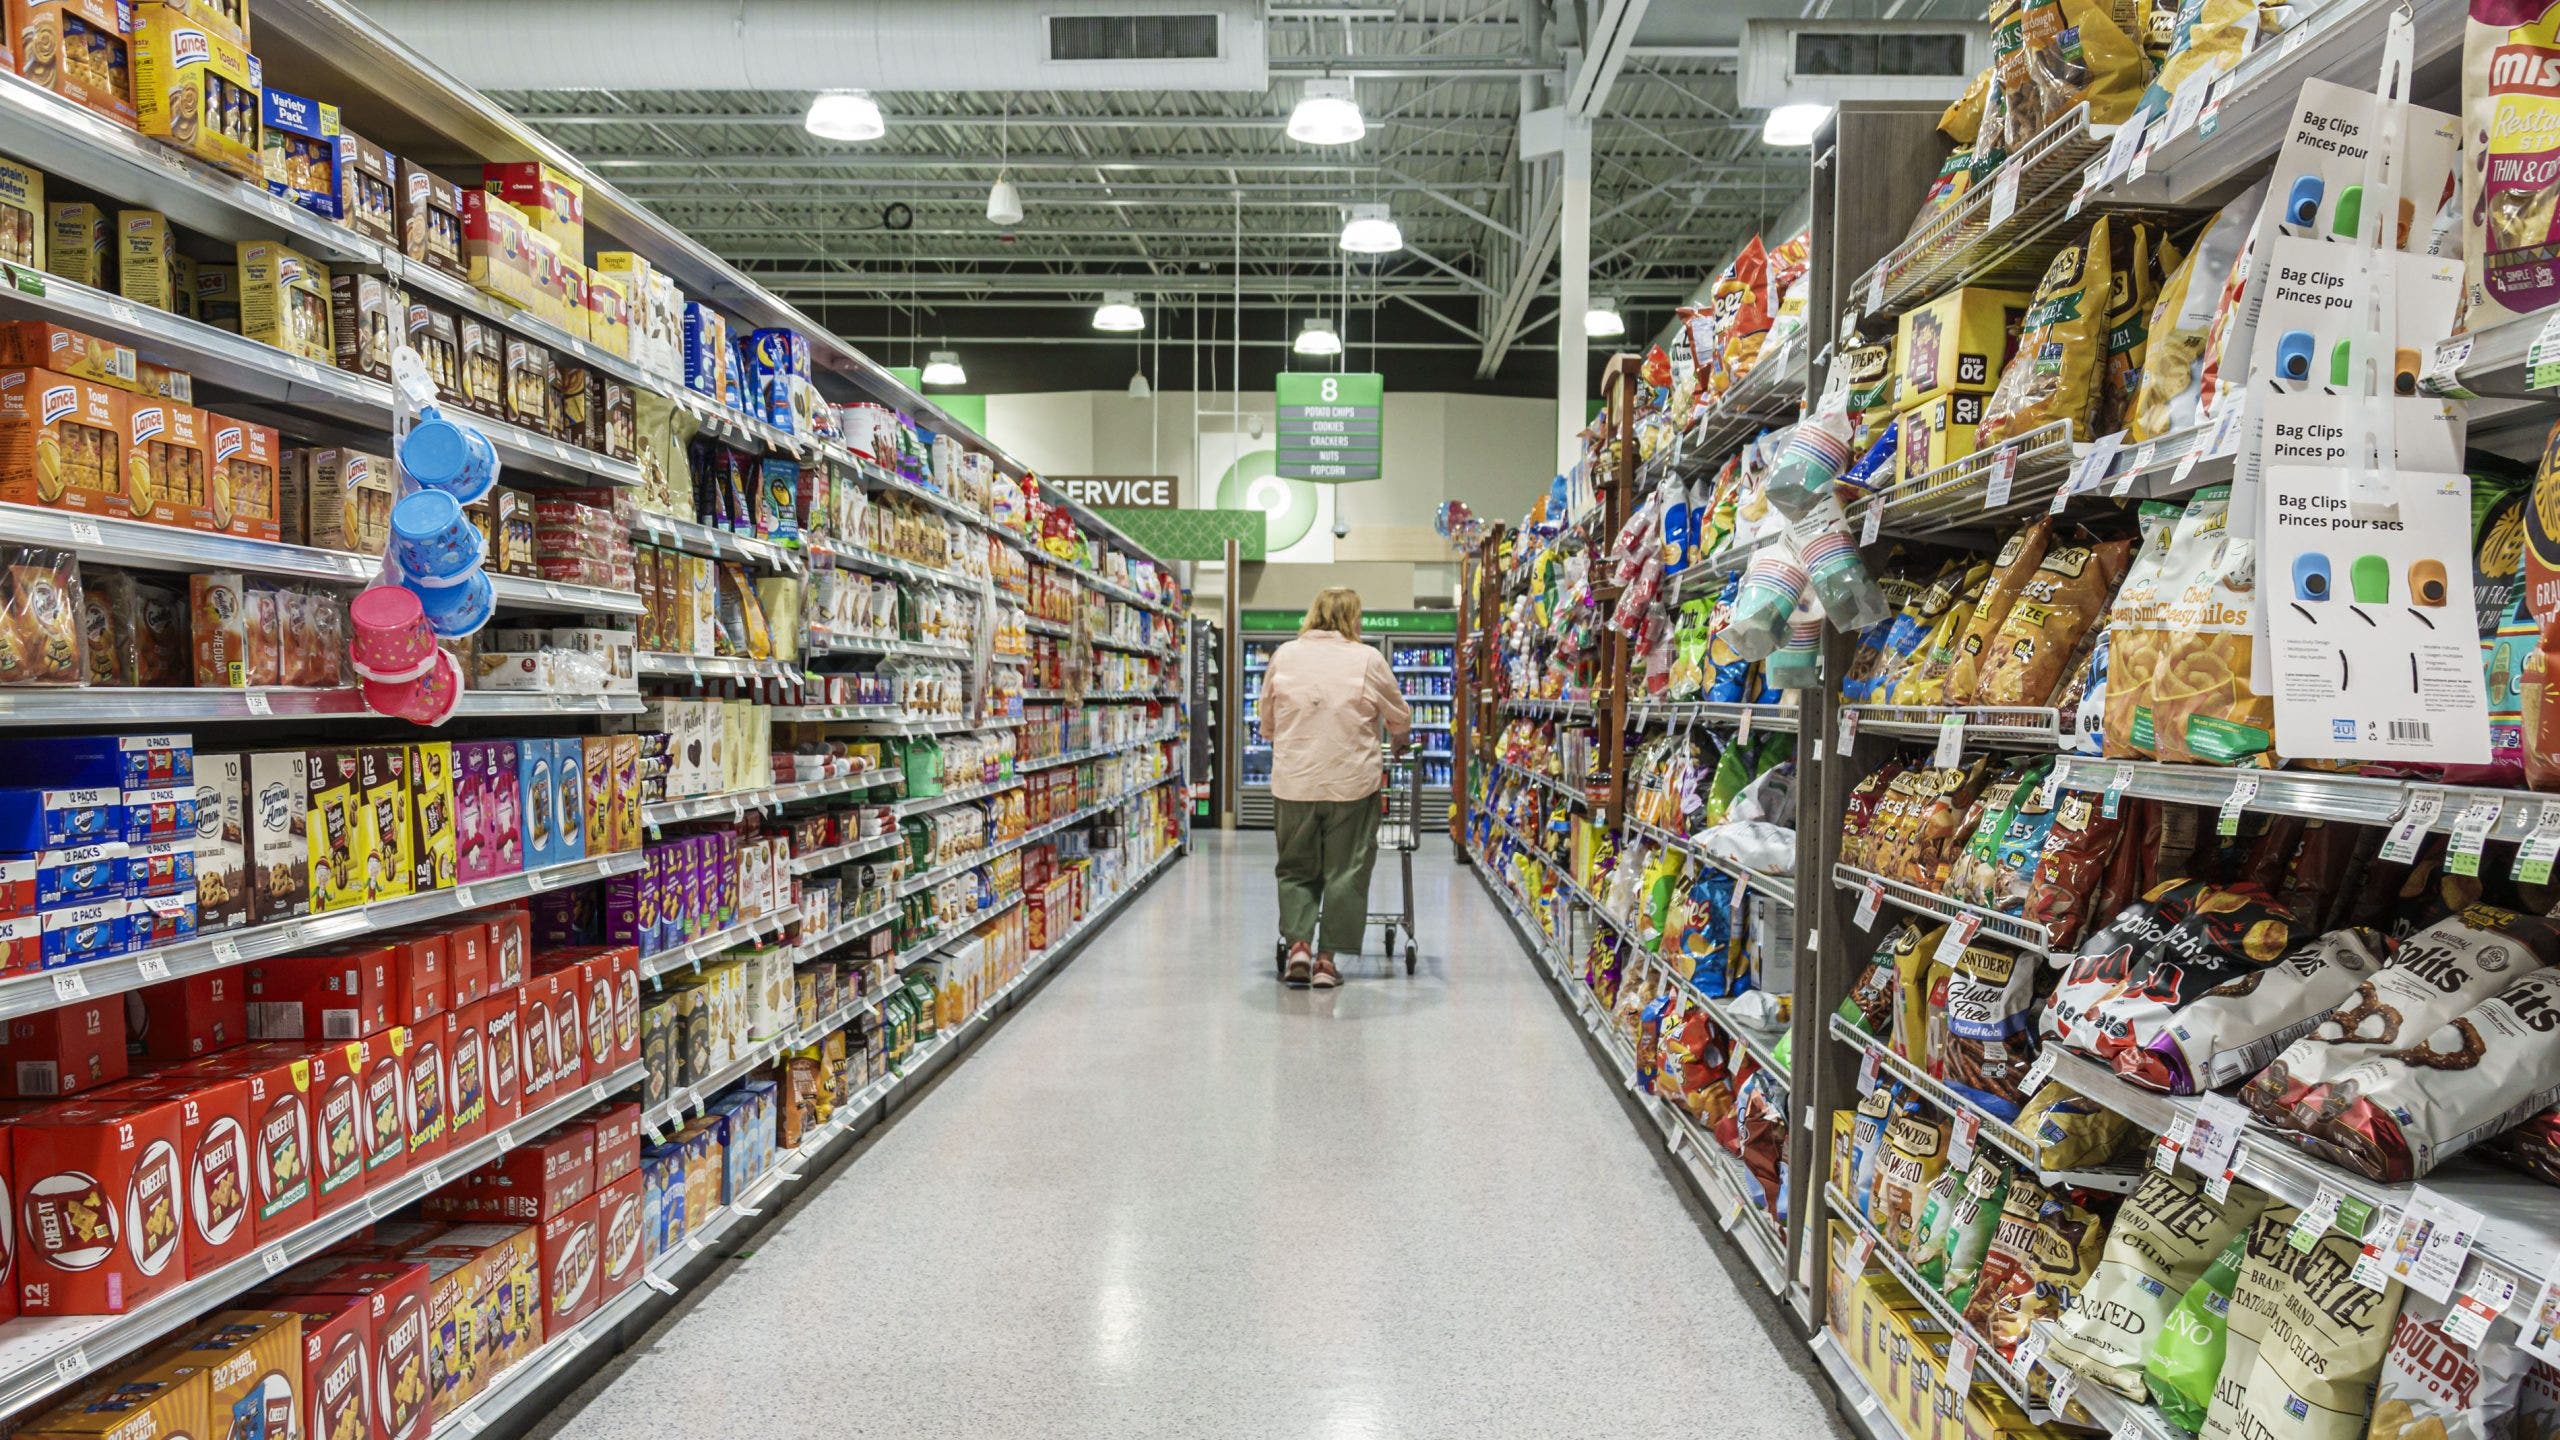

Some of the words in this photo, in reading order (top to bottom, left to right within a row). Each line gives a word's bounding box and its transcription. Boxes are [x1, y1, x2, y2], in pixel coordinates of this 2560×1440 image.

[174, 29, 209, 58] Lance
[271, 93, 306, 113] Variety
[279, 106, 303, 124] Pack
[2304, 111, 2326, 131] Bag
[2329, 117, 2359, 136] Clips
[2296, 131, 2336, 152] Pinces
[2338, 143, 2368, 160] pour
[2493, 160, 2520, 182] THIN
[2523, 163, 2536, 183] &
[2281, 267, 2307, 285] Bag
[2311, 272, 2344, 288] Clips
[2276, 288, 2321, 305] Pinces
[1960, 363, 1984, 380] 20
[87, 388, 108, 406] Toast
[1320, 378, 1338, 402] 8
[44, 390, 77, 416] Lance
[89, 404, 108, 419] Chee
[1956, 398, 1972, 423] 20
[172, 409, 193, 425] Toast
[1304, 406, 1331, 418] POTATO
[1333, 406, 1354, 417] CHIPS
[134, 412, 164, 437] Lance
[175, 422, 193, 438] Chee
[1312, 421, 1344, 432] COOKIES
[2276, 424, 2303, 439] Bag
[2307, 424, 2343, 440] Clips
[216, 429, 242, 452] Lance
[248, 428, 266, 444] Toast
[1310, 436, 1349, 447] CRACKERS
[250, 441, 266, 456] Chee
[1319, 451, 1339, 461] NUTS
[2275, 444, 2322, 457] Pinces
[1310, 465, 1345, 476] POPCORN
[2279, 494, 2307, 510] Bag
[2311, 496, 2348, 512] Clips
[2279, 514, 2328, 528] Pinces
[2332, 518, 2366, 531] pour
[2372, 519, 2404, 531] sacs
[213, 629, 227, 674] CHEDDAR
[154, 738, 170, 747] PACKS
[363, 754, 375, 774] 12
[452, 750, 461, 768] 12
[488, 748, 495, 766] 12
[225, 762, 237, 776] 10
[292, 760, 303, 773] 10
[310, 757, 323, 775] 12
[69, 792, 76, 801] 12
[77, 790, 98, 801] PACKS
[158, 790, 173, 799] PACKS
[2411, 800, 2432, 815] 5.49
[74, 809, 95, 826] OREO
[64, 851, 71, 862] 12
[73, 847, 100, 860] PACKS
[155, 843, 171, 852] PACKS
[73, 865, 97, 881] OREO
[154, 899, 161, 908] 12
[162, 897, 178, 907] PACKS
[71, 912, 79, 923] 12
[81, 908, 102, 921] PACKS
[75, 926, 98, 942] OREO
[1962, 950, 2011, 976] SNYDER'S
[58, 979, 75, 991] 7.99
[211, 979, 223, 995] 12
[87, 1010, 100, 1027] 12
[1954, 1002, 1991, 1022] Free
[314, 1060, 325, 1075] 12
[252, 1078, 265, 1094] 12
[184, 1101, 198, 1119] 12
[119, 1124, 133, 1142] 12
[2122, 1233, 2175, 1274] CHIPS
[25, 1283, 41, 1307] 12
[372, 1294, 385, 1309] 20
[2286, 1294, 2315, 1326] BRAND
[308, 1337, 321, 1352] 20
[2289, 1333, 2328, 1375] CHIPS
[59, 1358, 77, 1372] 9.49
[213, 1366, 228, 1383] 20
[2392, 1354, 2453, 1402] CANYON
